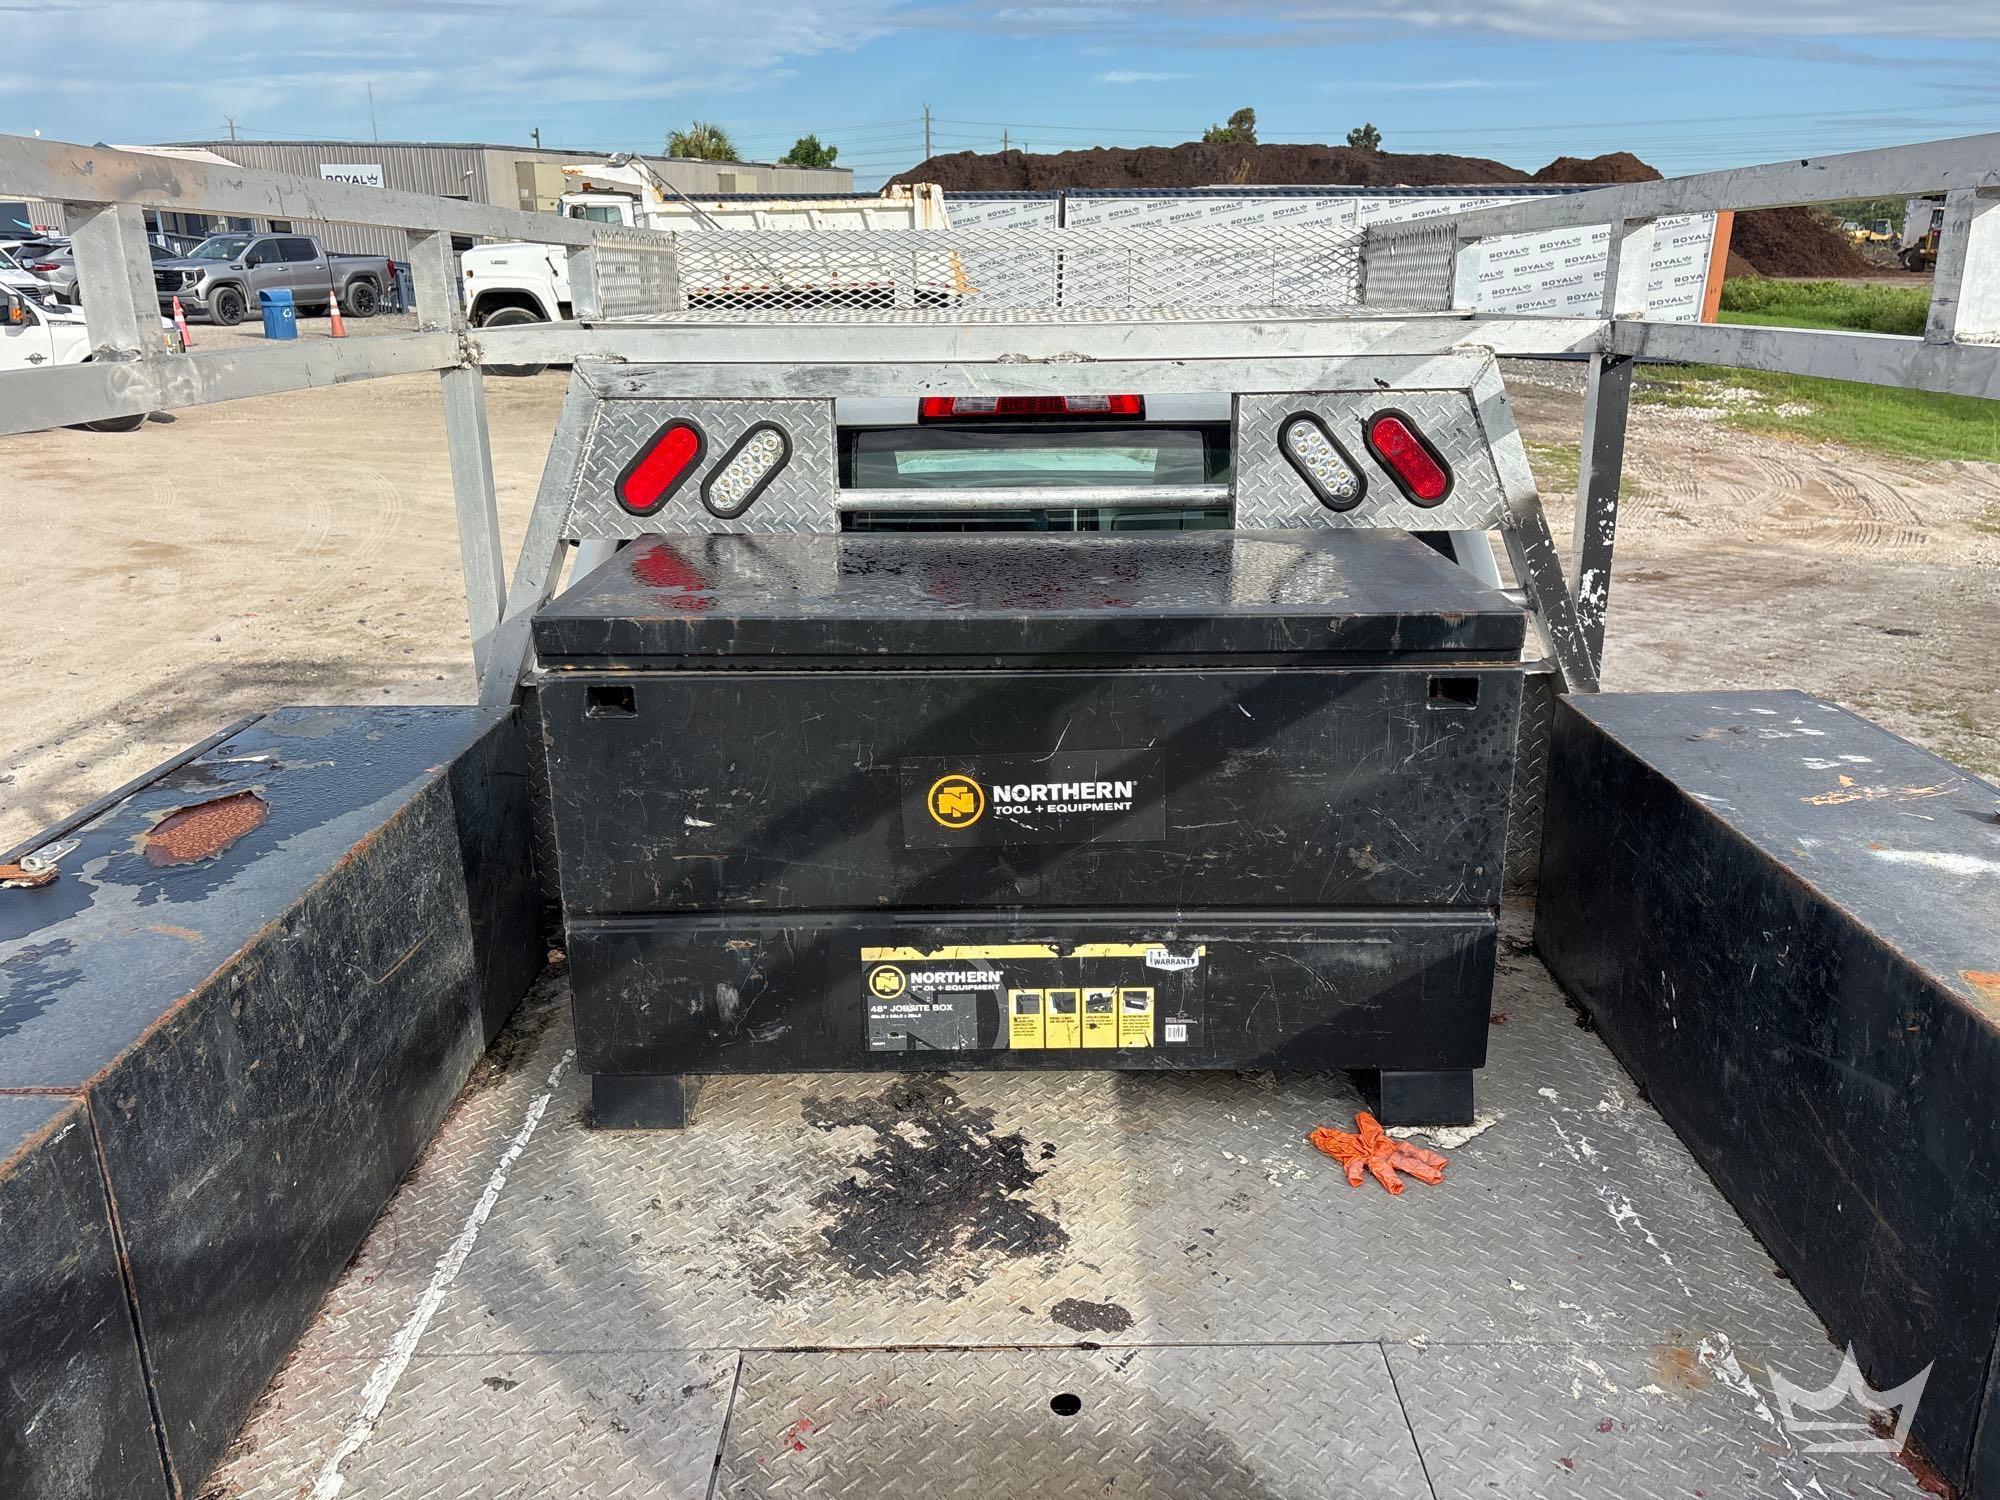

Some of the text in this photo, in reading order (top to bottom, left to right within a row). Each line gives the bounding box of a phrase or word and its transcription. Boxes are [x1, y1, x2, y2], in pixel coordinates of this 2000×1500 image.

[1412, 208, 1442, 218] ROYAL
[1673, 233, 1707, 244] ROYAL
[1540, 239, 1572, 250] ROYAL
[1489, 248, 1521, 259] ROYAL
[1565, 253, 1597, 264] ROYAL
[1513, 263, 1545, 273] ROYAL
[1542, 276, 1573, 287] ROYAL
[1492, 285, 1523, 296] ROYAL
[1567, 291, 1599, 301] ROYAL
[1516, 300, 1548, 310] ROYAL
[1649, 296, 1684, 307] ROYAL
[994, 805, 1031, 815] TOOL
[1050, 802, 1132, 813] EQUIPMENT
[890, 1004, 931, 1012] JOBSITE
